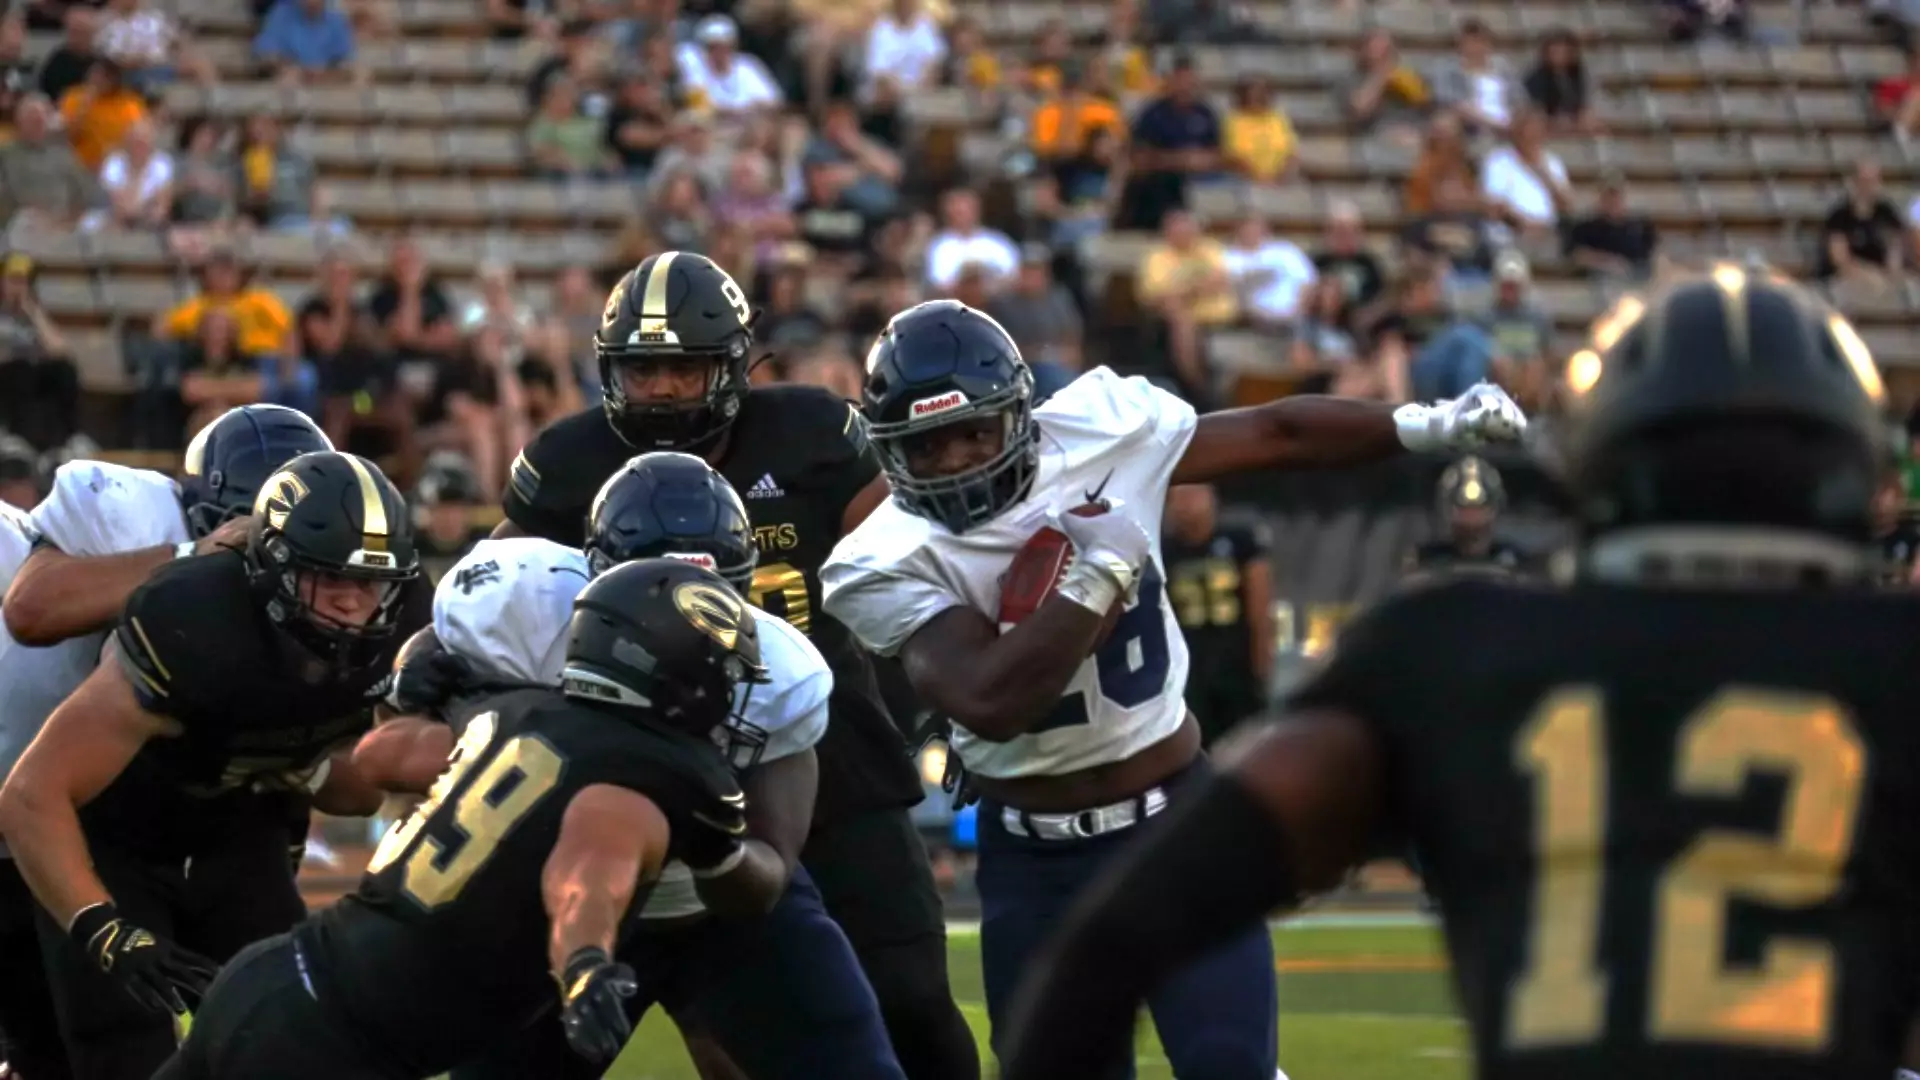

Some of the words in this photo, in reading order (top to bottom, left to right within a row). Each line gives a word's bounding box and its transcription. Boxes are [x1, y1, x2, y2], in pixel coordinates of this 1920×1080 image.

[721, 278, 751, 326] 9
[914, 394, 961, 415] Riddell
[746, 488, 786, 499] adidas
[1509, 685, 1866, 1048] 12
